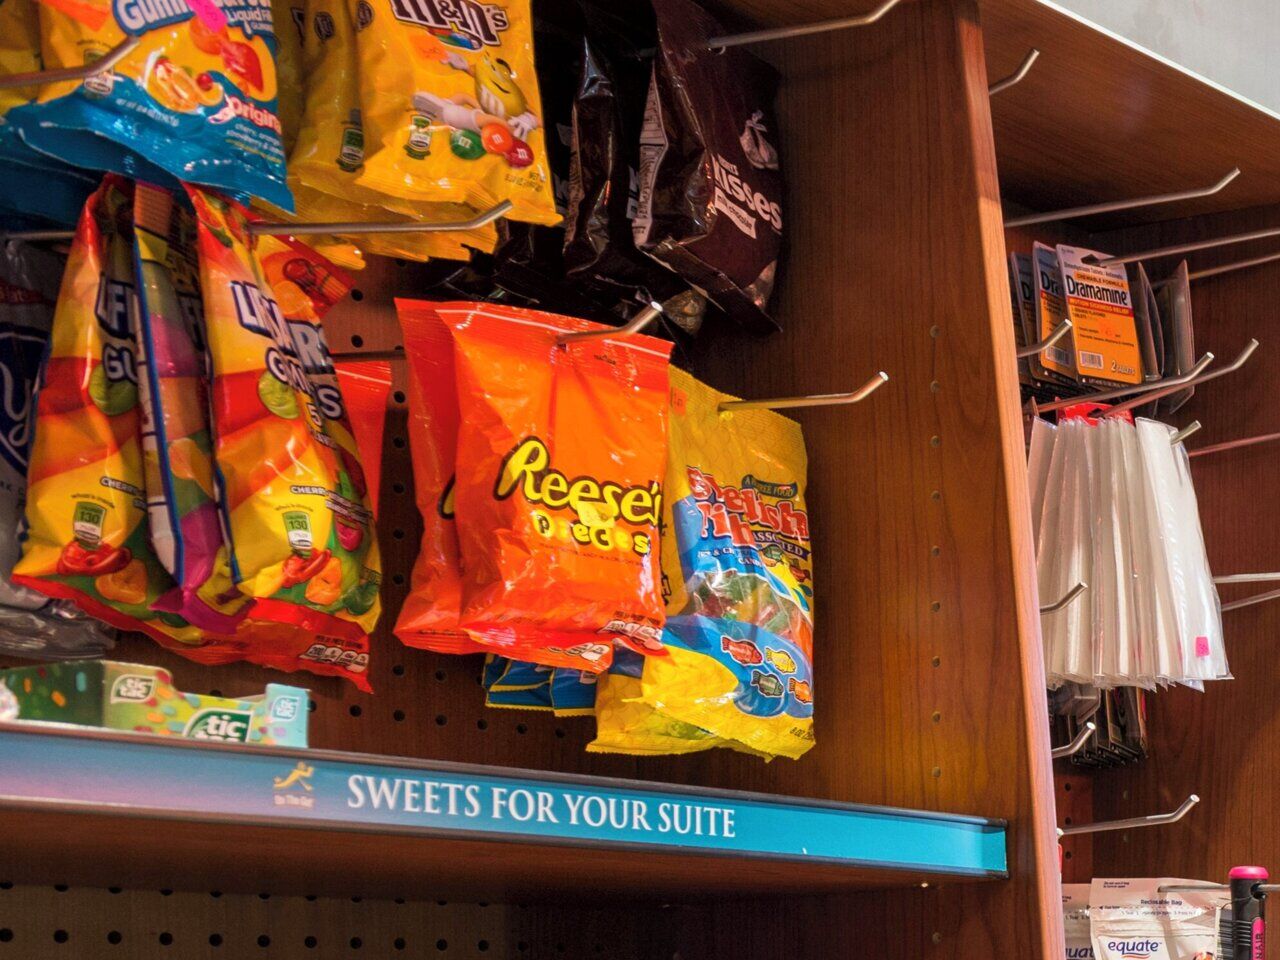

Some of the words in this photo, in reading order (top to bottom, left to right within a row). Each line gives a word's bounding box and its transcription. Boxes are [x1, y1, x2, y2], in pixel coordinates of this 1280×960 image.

[1065, 274, 1128, 307] Dramamine
[288, 519, 308, 532] 130
[205, 713, 247, 738] tic
[347, 774, 480, 817] SWEETS
[491, 788, 560, 823] FOR
[562, 794, 652, 831] YOUR
[658, 802, 737, 839] SUITE
[1107, 940, 1159, 955] equate
